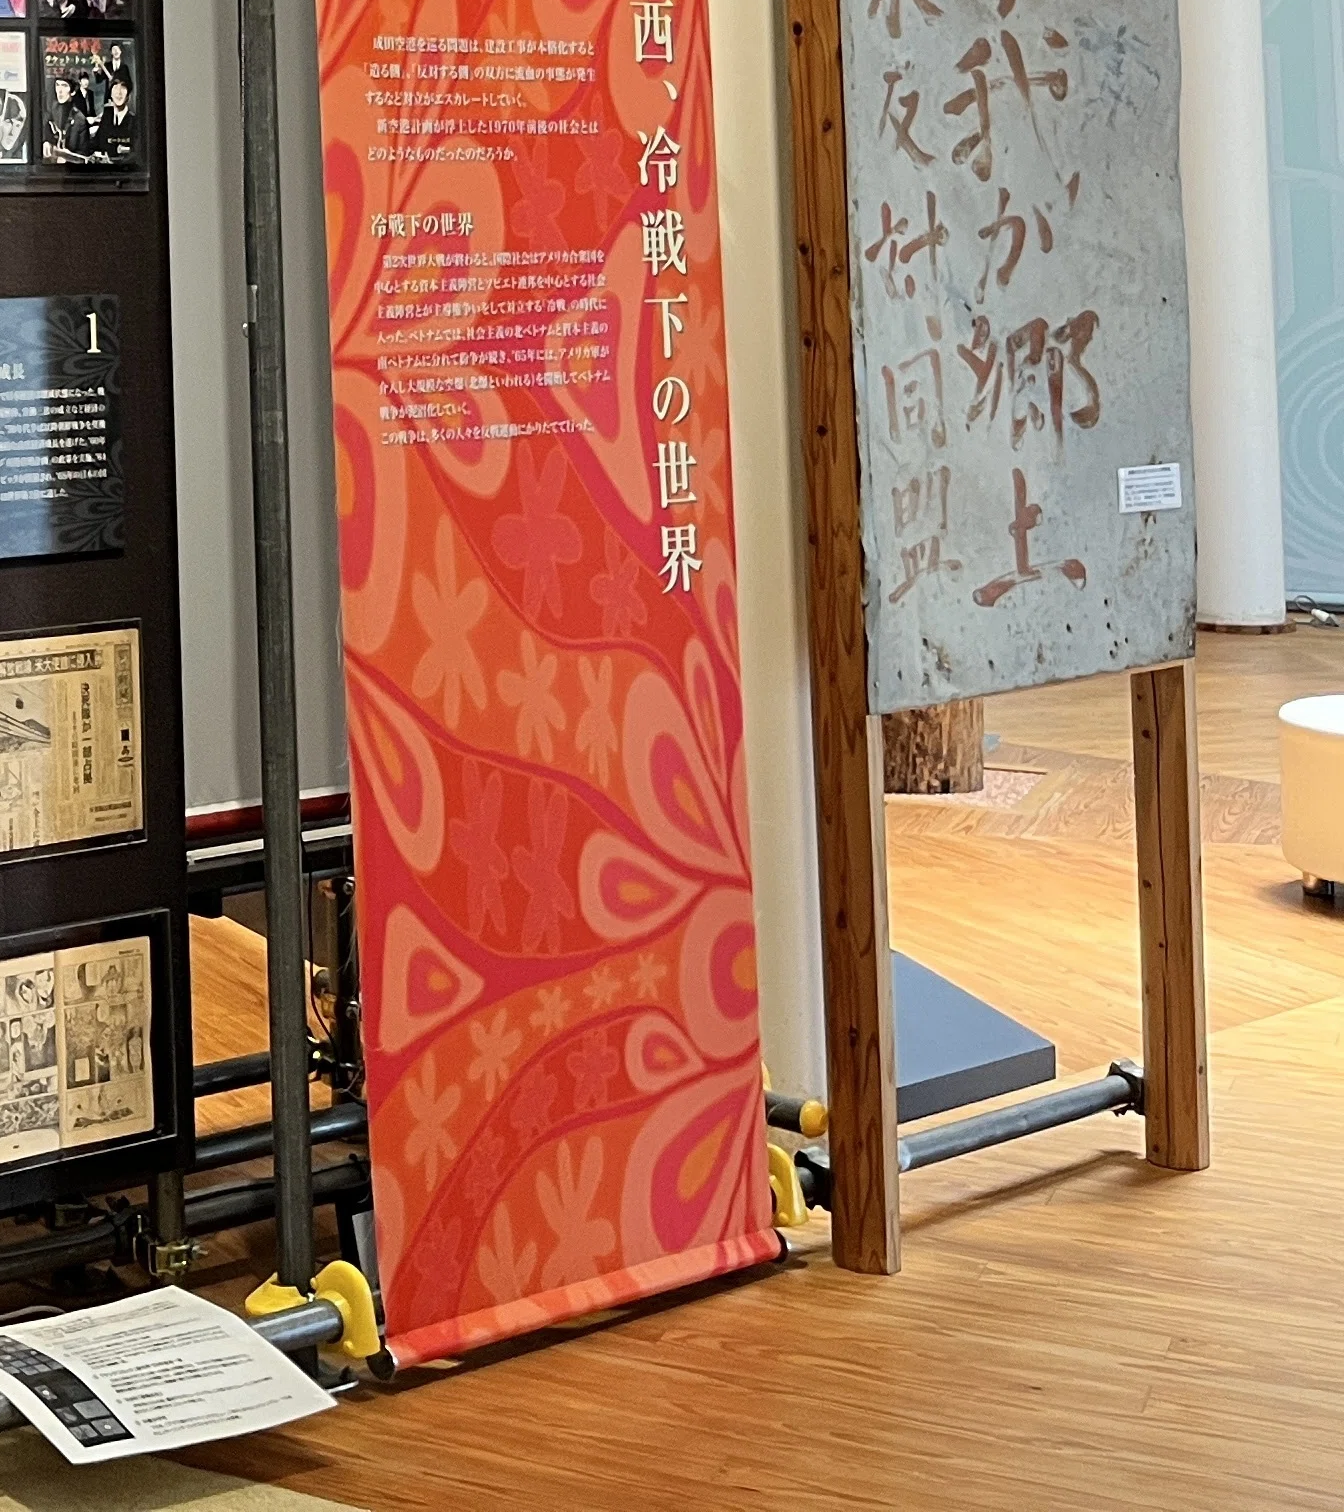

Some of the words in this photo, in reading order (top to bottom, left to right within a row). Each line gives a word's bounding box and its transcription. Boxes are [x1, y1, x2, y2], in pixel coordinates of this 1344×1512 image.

[370, 213, 474, 238] 冷戦下の世界
[86, 313, 102, 354] 1
